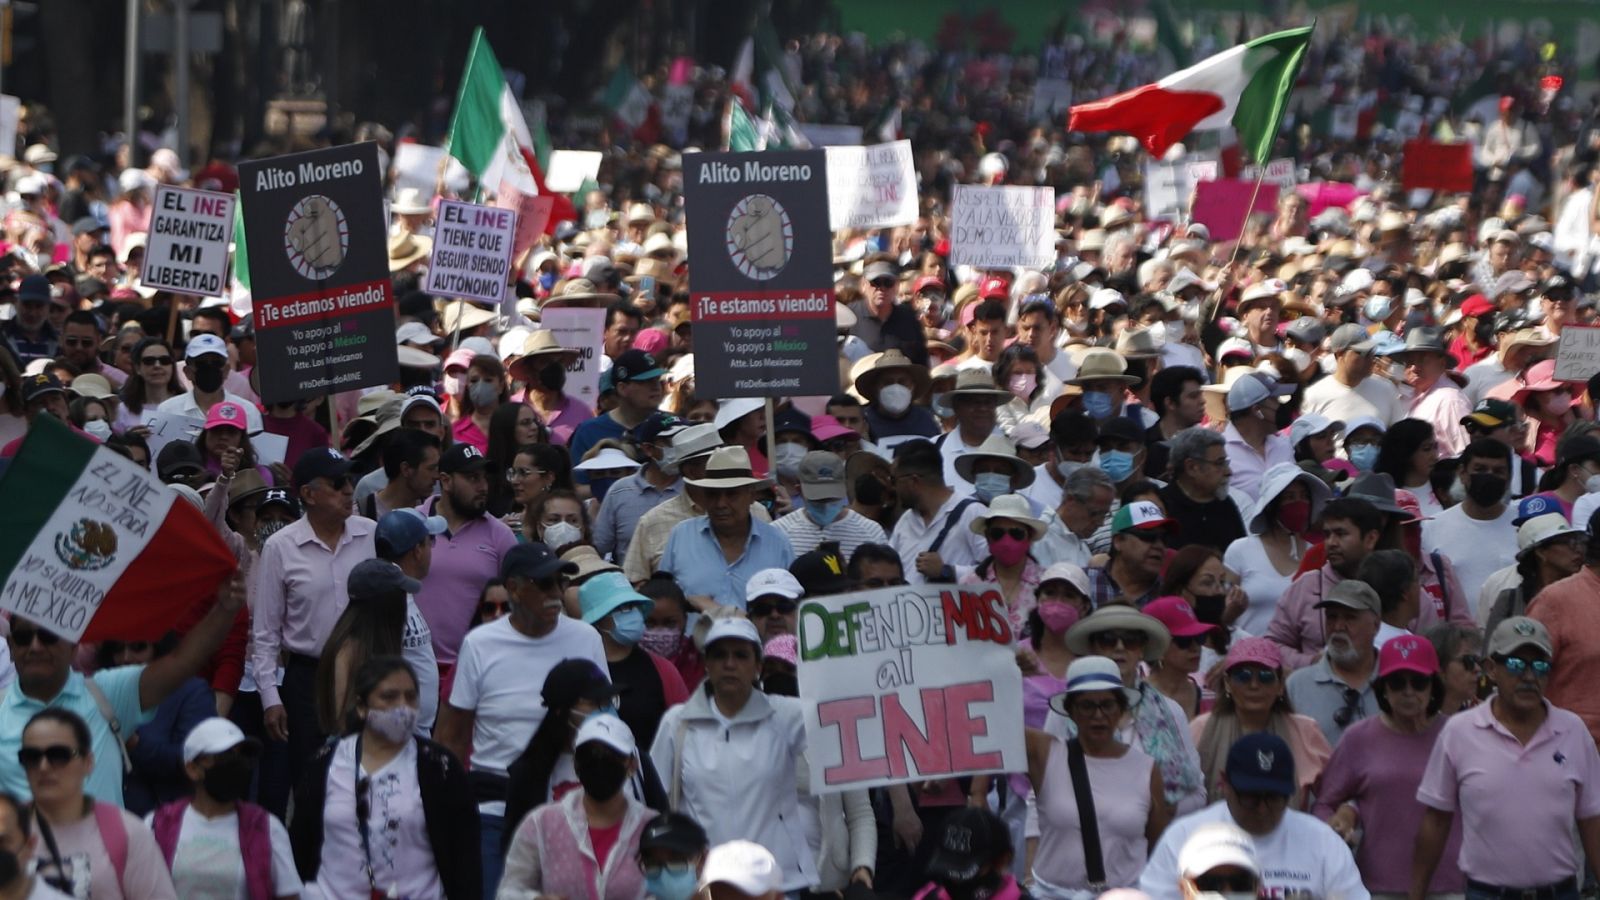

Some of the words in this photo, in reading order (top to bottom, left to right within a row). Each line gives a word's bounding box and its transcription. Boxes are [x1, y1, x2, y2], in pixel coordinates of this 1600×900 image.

[256, 168, 296, 191] Alito
[299, 159, 363, 184] Moreno
[700, 162, 741, 183] Alito
[744, 161, 811, 181] Moreno
[163, 192, 186, 211] EL
[193, 195, 227, 217] INE
[156, 216, 224, 242] GARANTIZA
[445, 206, 467, 224] EL
[474, 210, 509, 229] INE
[443, 228, 476, 248] TIENE
[478, 233, 502, 252] QUE
[169, 243, 202, 264] MI
[436, 250, 470, 270] SEGUIR
[471, 254, 506, 275] SIENDO
[147, 265, 219, 292] LIBERTAD
[433, 271, 500, 297] AUTÓNOMO
[260, 304, 279, 327] ¡Te
[282, 297, 335, 318] estamos
[336, 284, 385, 308] viendo!
[698, 297, 717, 319] ¡Te
[720, 298, 776, 313] estamos
[778, 293, 828, 312] viendo!
[292, 330, 304, 341] Yo
[305, 326, 332, 340] apoyo
[333, 322, 341, 334] al
[730, 327, 742, 337] Yo
[743, 328, 771, 340] apoyo
[773, 326, 781, 336] al
[286, 345, 298, 356] Yo
[299, 342, 326, 356] apoyo
[328, 341, 334, 350] a
[312, 358, 325, 368] Los
[325, 351, 364, 365] Mexicanos
[723, 342, 735, 352] Yo
[736, 343, 765, 355] apoyo
[749, 358, 763, 367] Los
[763, 357, 803, 366] Mexicanos
[90, 461, 122, 485] EL
[110, 473, 161, 517] INE
[70, 486, 106, 507] NO
[112, 506, 149, 539] TOCA
[6, 580, 18, 600] A
[52, 570, 104, 607] QUIERO
[800, 590, 1013, 661] DEFENDEMOS
[877, 648, 914, 689] al
[817, 680, 1004, 786] INE
